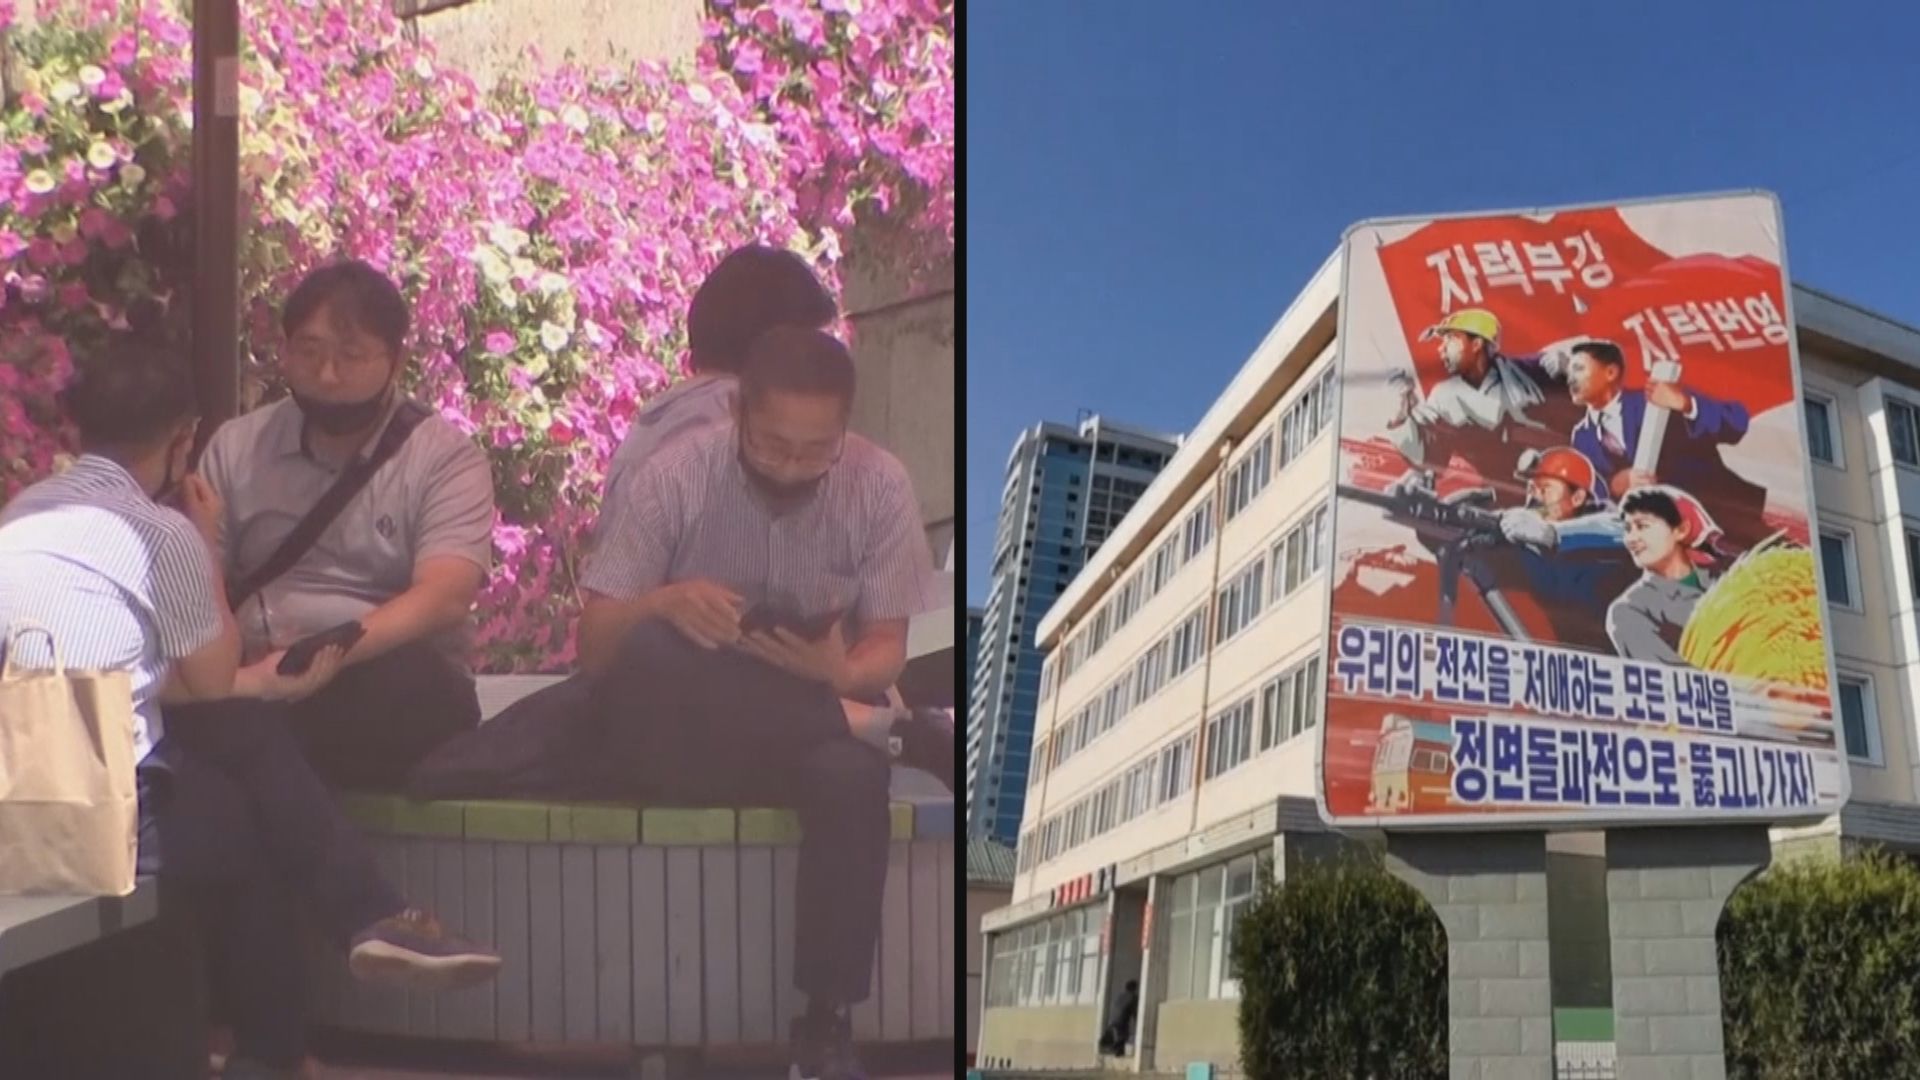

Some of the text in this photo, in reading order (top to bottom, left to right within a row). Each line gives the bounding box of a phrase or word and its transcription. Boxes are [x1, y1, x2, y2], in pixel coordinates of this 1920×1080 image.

[1426, 230, 1614, 313] 자력부강
[1623, 292, 1790, 371] 자력번영
[1337, 627, 1734, 732] 우리의 전진을 저애하는 모든 난관을
[1453, 719, 1681, 806] 정면돌파전으로
